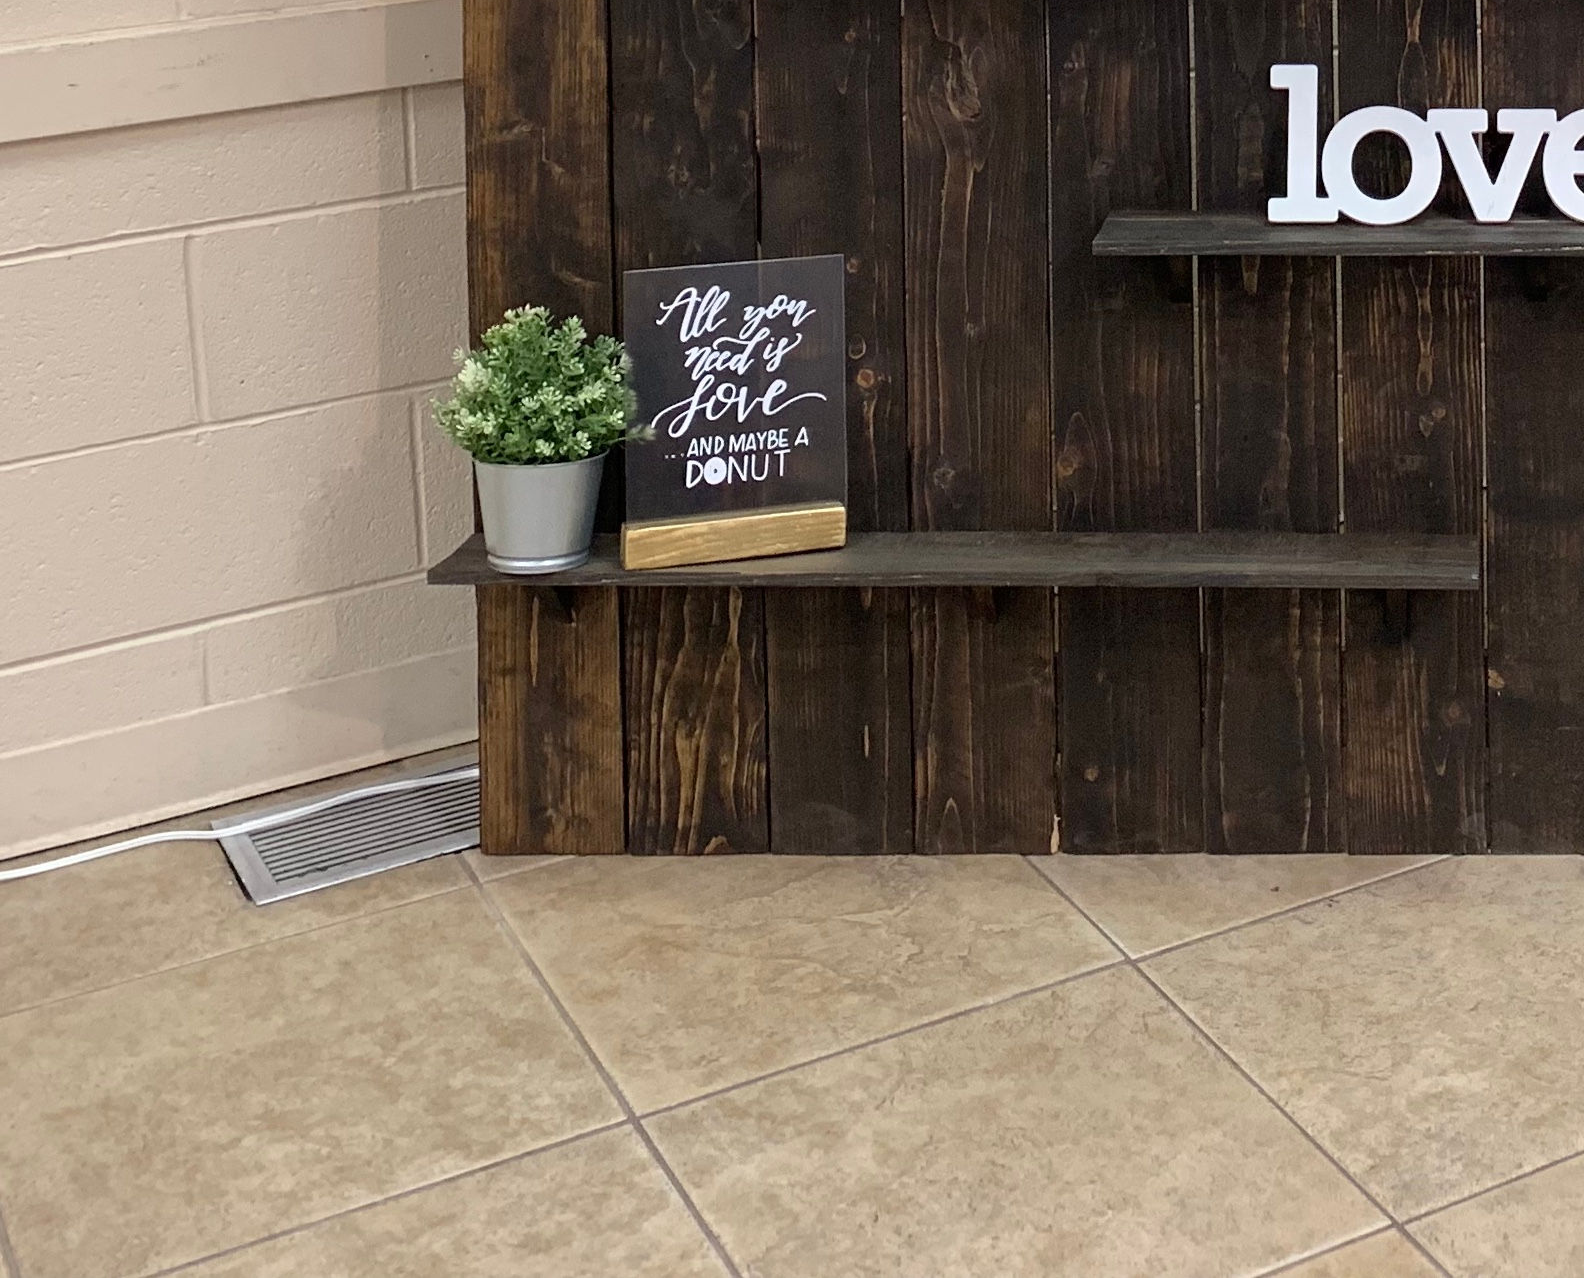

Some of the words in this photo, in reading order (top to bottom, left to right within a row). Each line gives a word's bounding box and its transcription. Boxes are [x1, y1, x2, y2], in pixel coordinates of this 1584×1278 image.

[656, 285, 730, 342] All
[740, 294, 816, 339] you
[684, 327, 770, 381] need
[763, 333, 803, 371] is
[729, 428, 789, 453] MAYBE
[794, 426, 810, 448] A
[685, 448, 791, 489] DONUT
